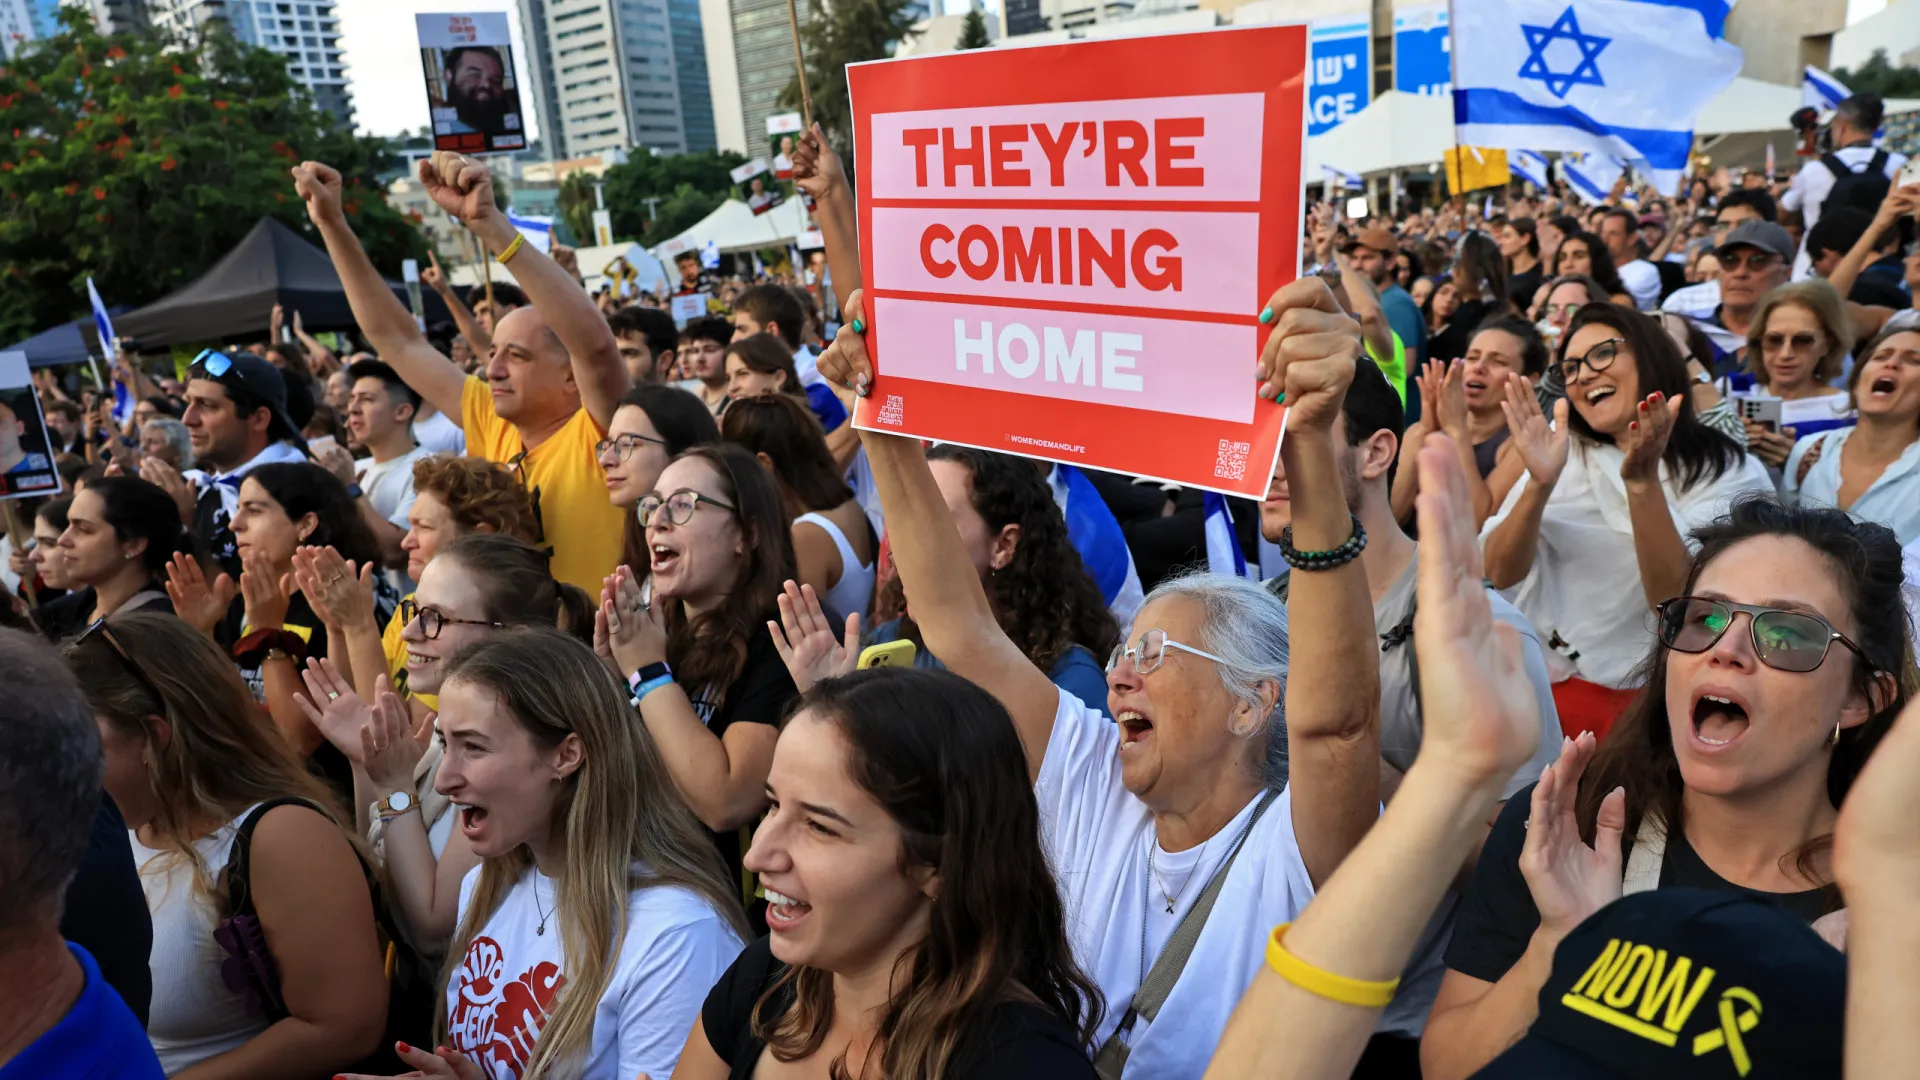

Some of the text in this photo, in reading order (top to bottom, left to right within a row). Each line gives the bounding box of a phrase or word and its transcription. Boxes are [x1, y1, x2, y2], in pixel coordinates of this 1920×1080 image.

[902, 116, 1205, 188] THEY'RE
[920, 223, 1183, 292] COMING
[954, 319, 1143, 392] HOME
[1011, 435, 1085, 453] WOMENDEMANDLIFE
[1570, 938, 1716, 1033] NOW
